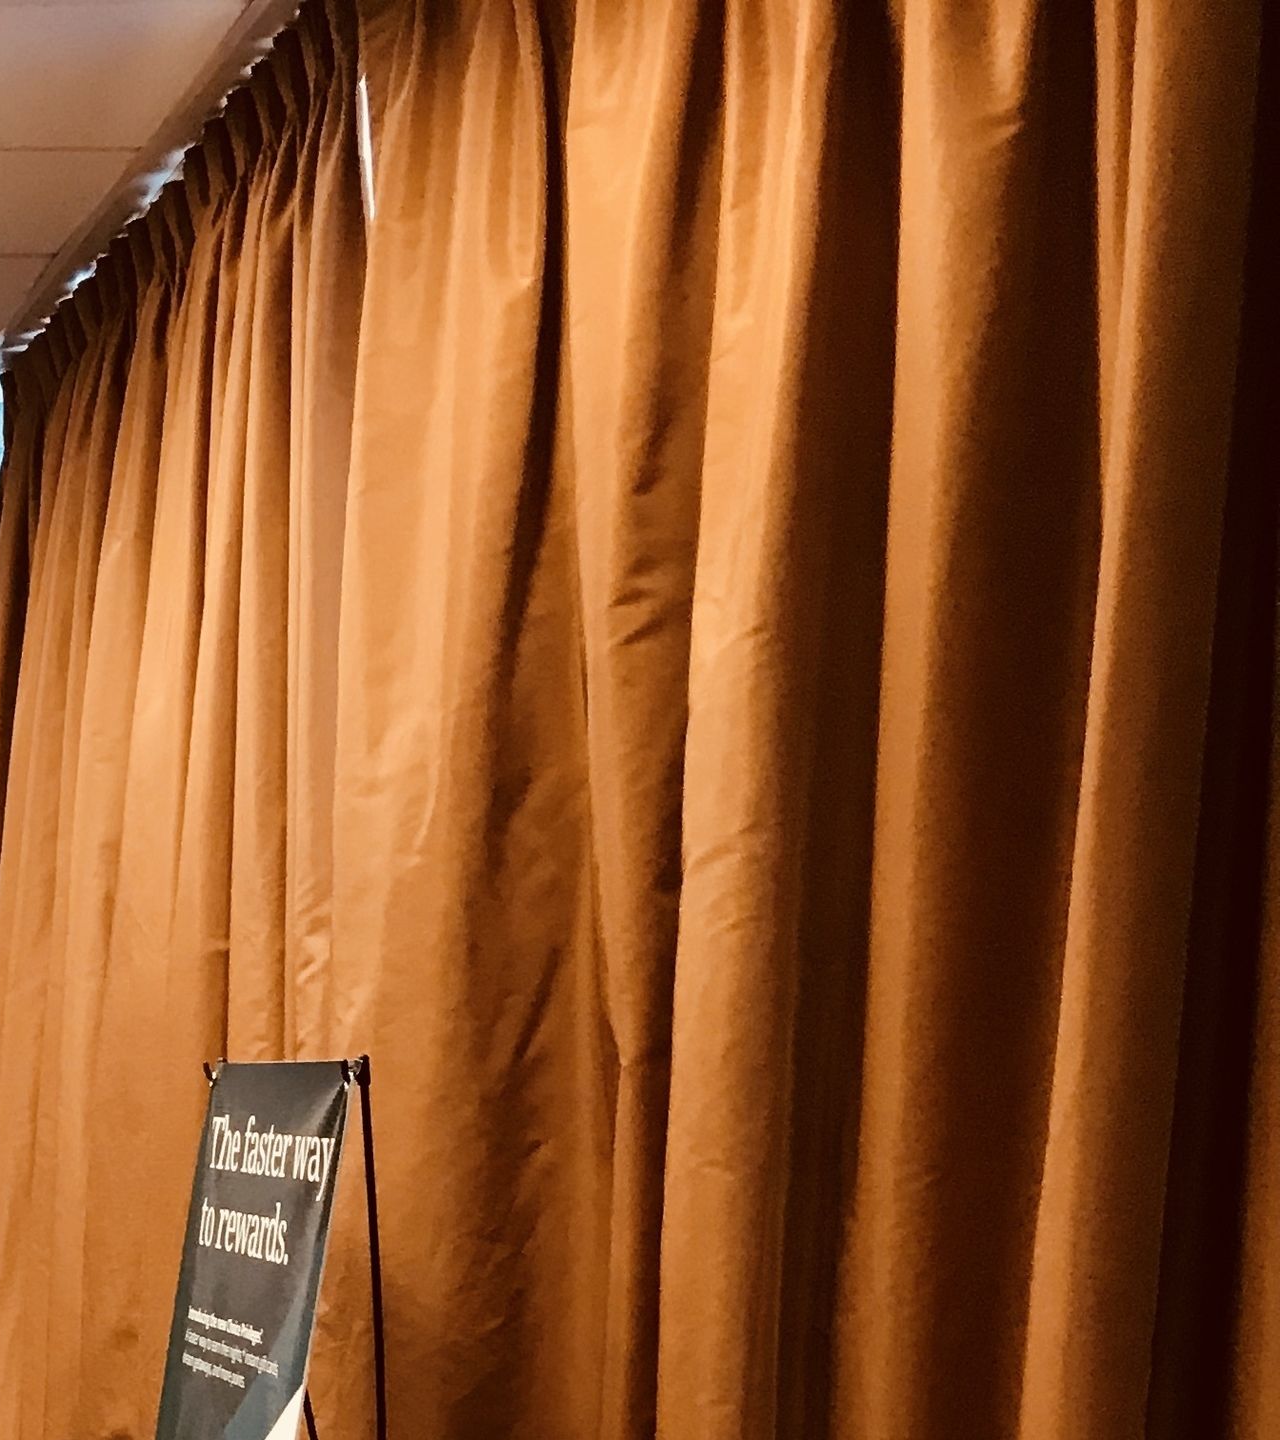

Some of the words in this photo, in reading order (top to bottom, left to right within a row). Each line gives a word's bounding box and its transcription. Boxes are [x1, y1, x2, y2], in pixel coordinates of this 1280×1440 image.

[209, 1114, 241, 1171] The
[241, 1115, 291, 1179] faster
[292, 1136, 336, 1202] way
[198, 1197, 215, 1247] to
[215, 1202, 288, 1265] rewards.
